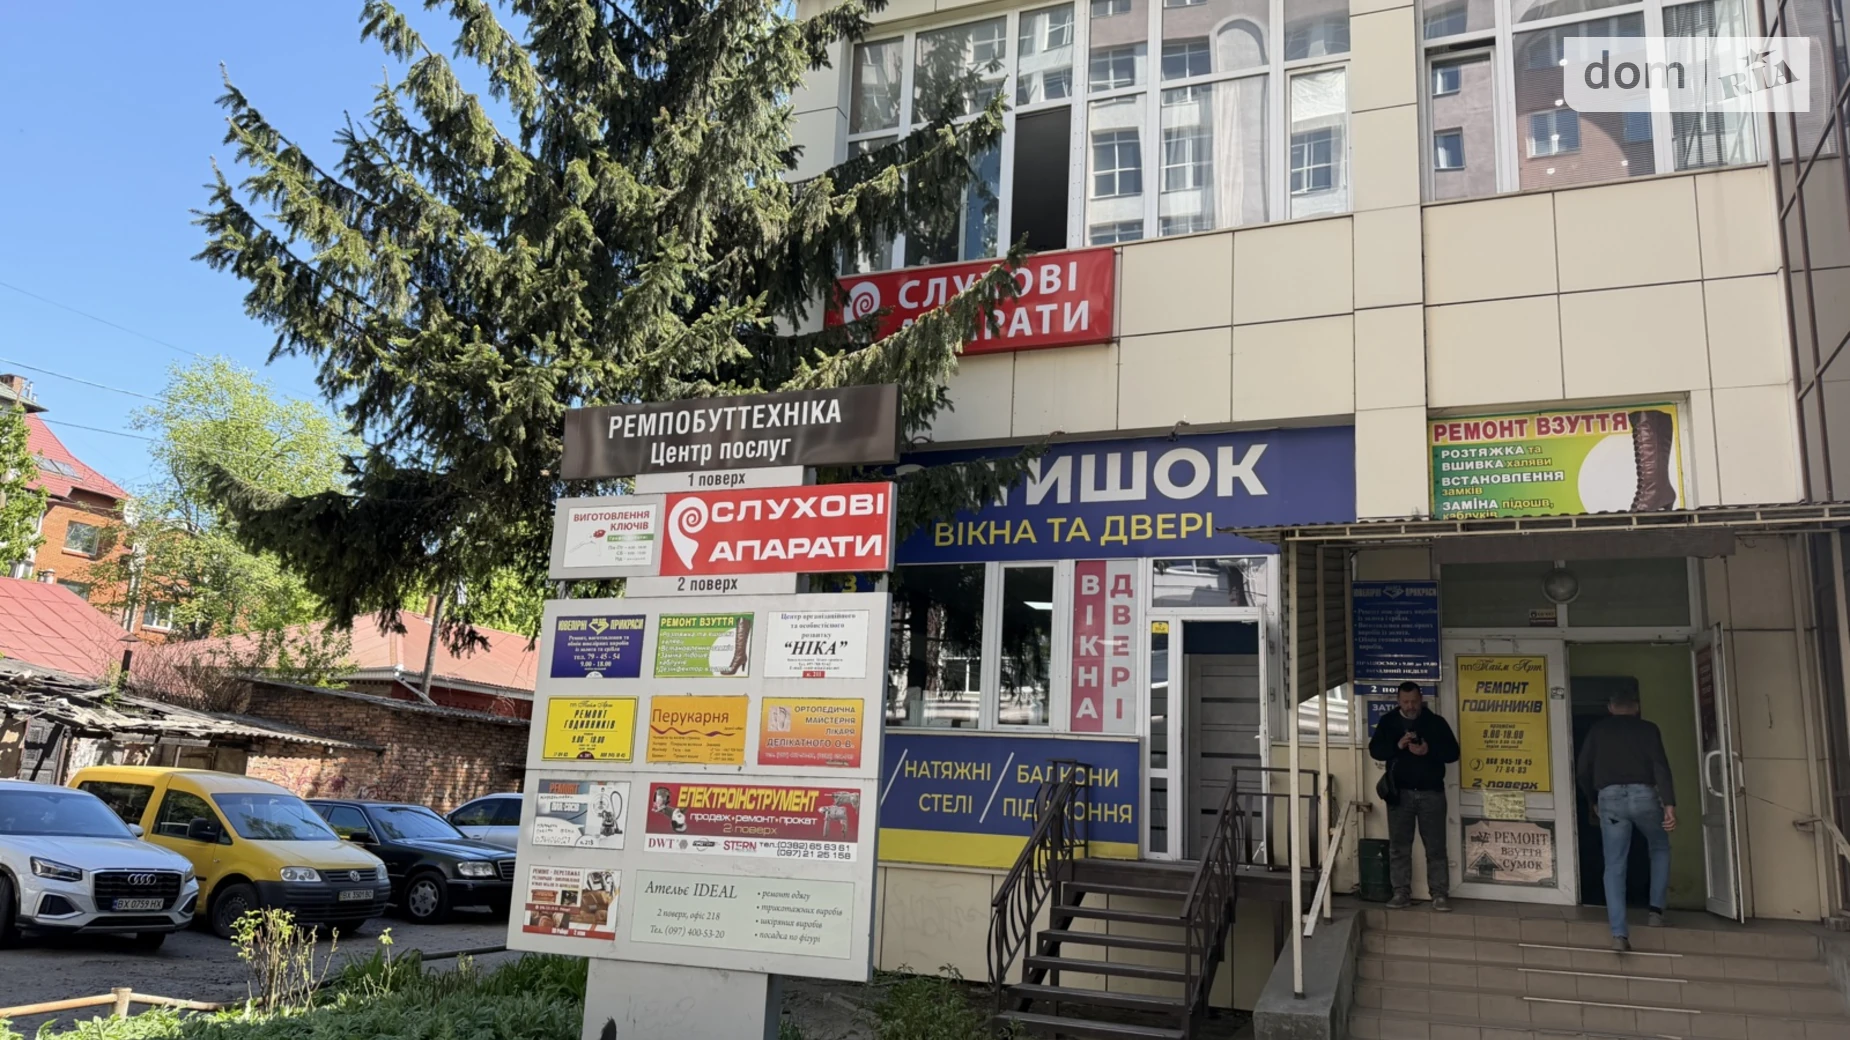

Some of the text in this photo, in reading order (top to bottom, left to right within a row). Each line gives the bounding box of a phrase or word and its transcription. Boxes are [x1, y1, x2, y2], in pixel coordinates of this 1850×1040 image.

[608, 399, 841, 439] РЕМПОБУТТЕХНІКА
[1434, 412, 1629, 442] РЕМОНТ ВЗУТТЯ
[651, 437, 791, 466] Центр послуг
[1442, 446, 1525, 459] РОЗТЯЖКА
[1442, 458, 1552, 471] ВШИВКА халяви
[688, 472, 745, 489] 1 поверх
[1442, 471, 1564, 486] ВСТАНОВЛЕННЯ
[1442, 487, 1483, 496] замків
[711, 493, 884, 522] СЛУХОВІ
[1443, 498, 1554, 510] ЗАМІНА підошв,
[574, 511, 650, 522] ВИГОТОВЛЕННЯ
[610, 522, 649, 531] КЛЮЧІВ
[934, 511, 1212, 547] ВІКНА ТА ДВЕРІ
[708, 535, 882, 562] АПАРАТИ
[678, 577, 738, 594] 2 поверх
[661, 617, 734, 627] РЕМОНТ ВЗУТТЯ
[1076, 575, 1100, 718] ВІКНА
[1110, 574, 1133, 719] ДВЕРІ
[1476, 681, 1529, 694] РЕМОНТ
[1462, 700, 1543, 713] ГОДИННИКІВ
[574, 710, 607, 718] РЕМОНТ
[653, 709, 729, 726] Перукарня
[806, 716, 855, 724] МАЙСТЕРНЯ
[564, 720, 615, 729] ГОДИННИКІВ
[767, 739, 832, 747] ДЕЛІКАТНОГО
[905, 760, 991, 781] НАТЯЖНІ
[1472, 778, 1538, 790] 2 поверх
[677, 786, 819, 813] ЕЛЕКТРОІНСТРУМЕНТ
[919, 793, 972, 814] СТЕЛІ
[723, 824, 777, 835] 2 поверх
[648, 838, 675, 849] DWT
[1494, 831, 1548, 845] РЕМОНТ
[724, 841, 757, 851] STERN
[645, 881, 738, 899] Ательє IDEAL
[762, 891, 811, 902] ремонт одягу
[131, 900, 150, 908] 0759
[761, 904, 843, 917] трикотажних виробів
[657, 909, 721, 922] 2 поверх, офіс 218
[760, 918, 823, 930] шкіряних виробів
[665, 925, 686, 938] (097)
[688, 928, 725, 939] 400-53-20
[759, 931, 788, 942] посадка
